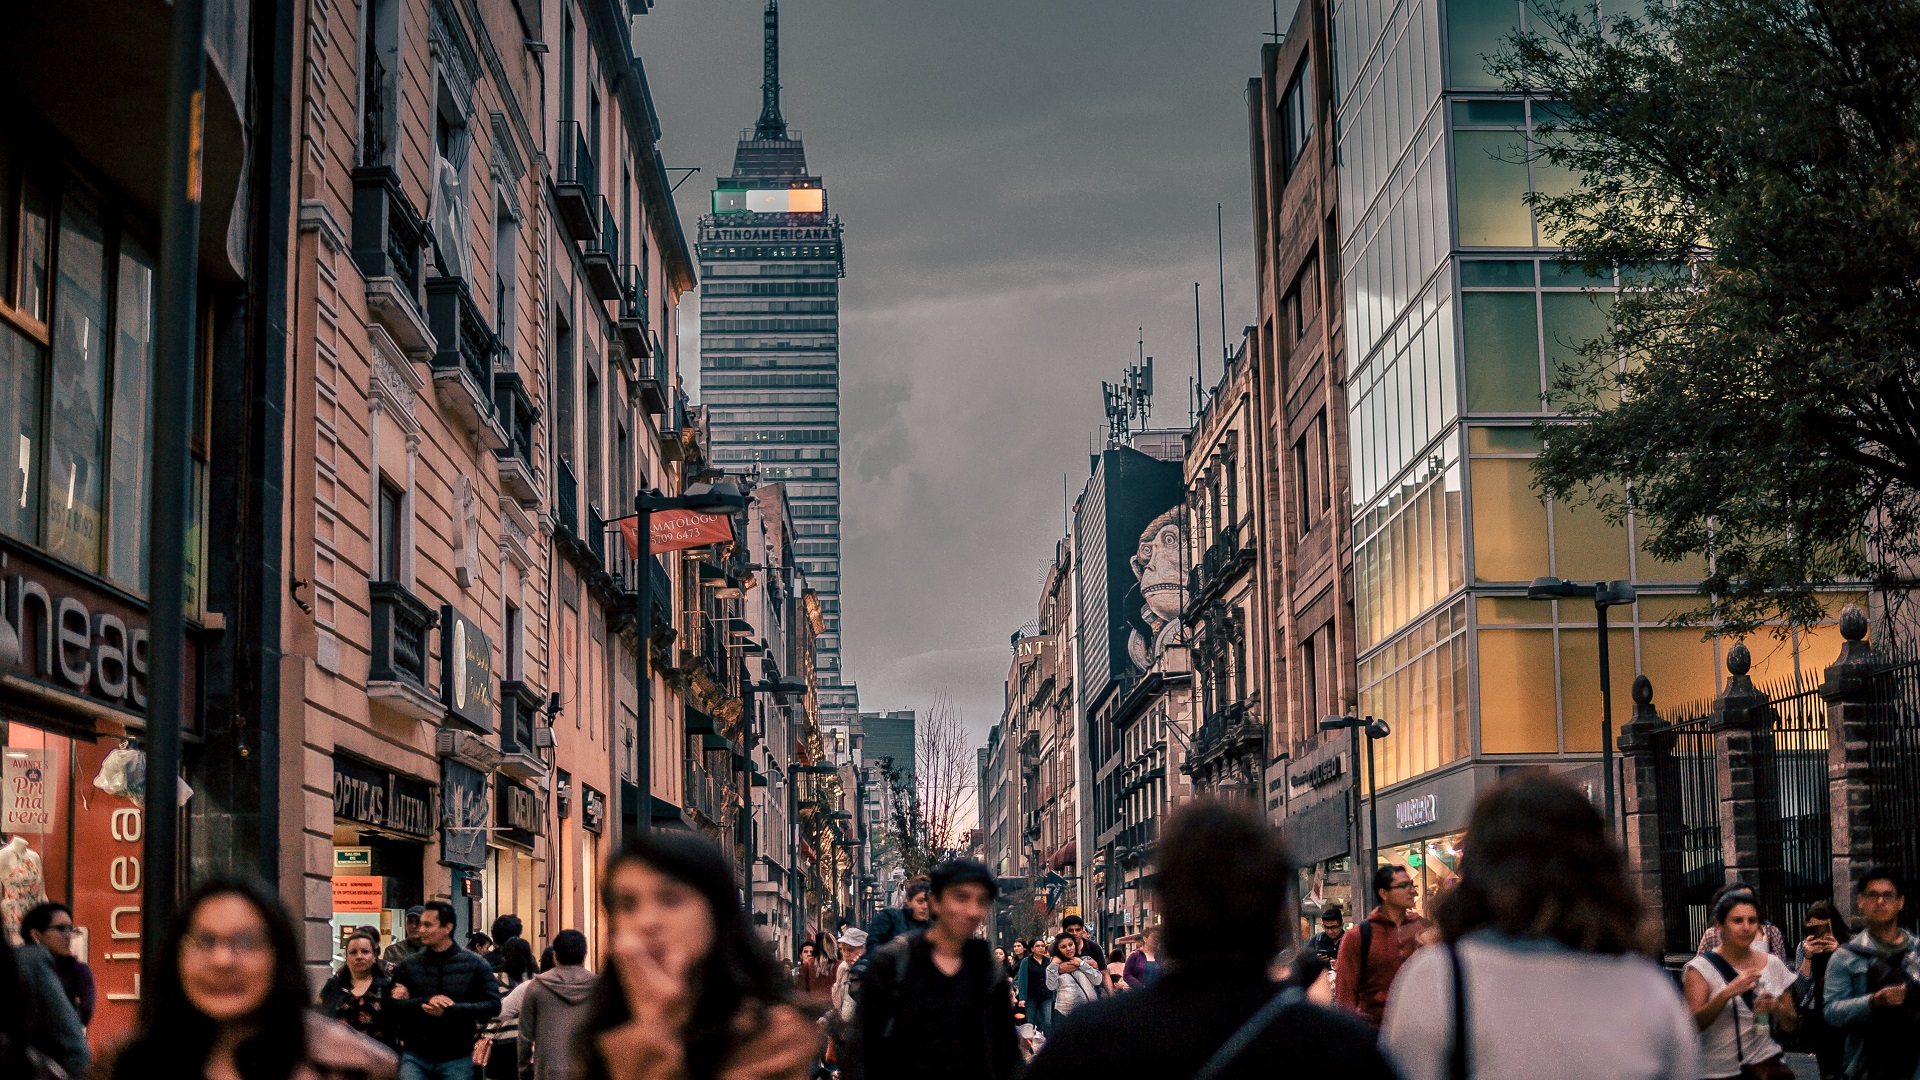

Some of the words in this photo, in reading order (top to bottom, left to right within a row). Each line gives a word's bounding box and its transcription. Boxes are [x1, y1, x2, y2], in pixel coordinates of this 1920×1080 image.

[706, 229, 830, 241] LATINOAMERICANA
[676, 527, 701, 540] 6473
[12, 759, 49, 770] AVANCES
[12, 776, 43, 795] Pri
[15, 795, 42, 809] ma
[334, 771, 383, 825] OPTICAS
[8, 811, 49, 825] vera
[104, 807, 142, 1000] Linea
